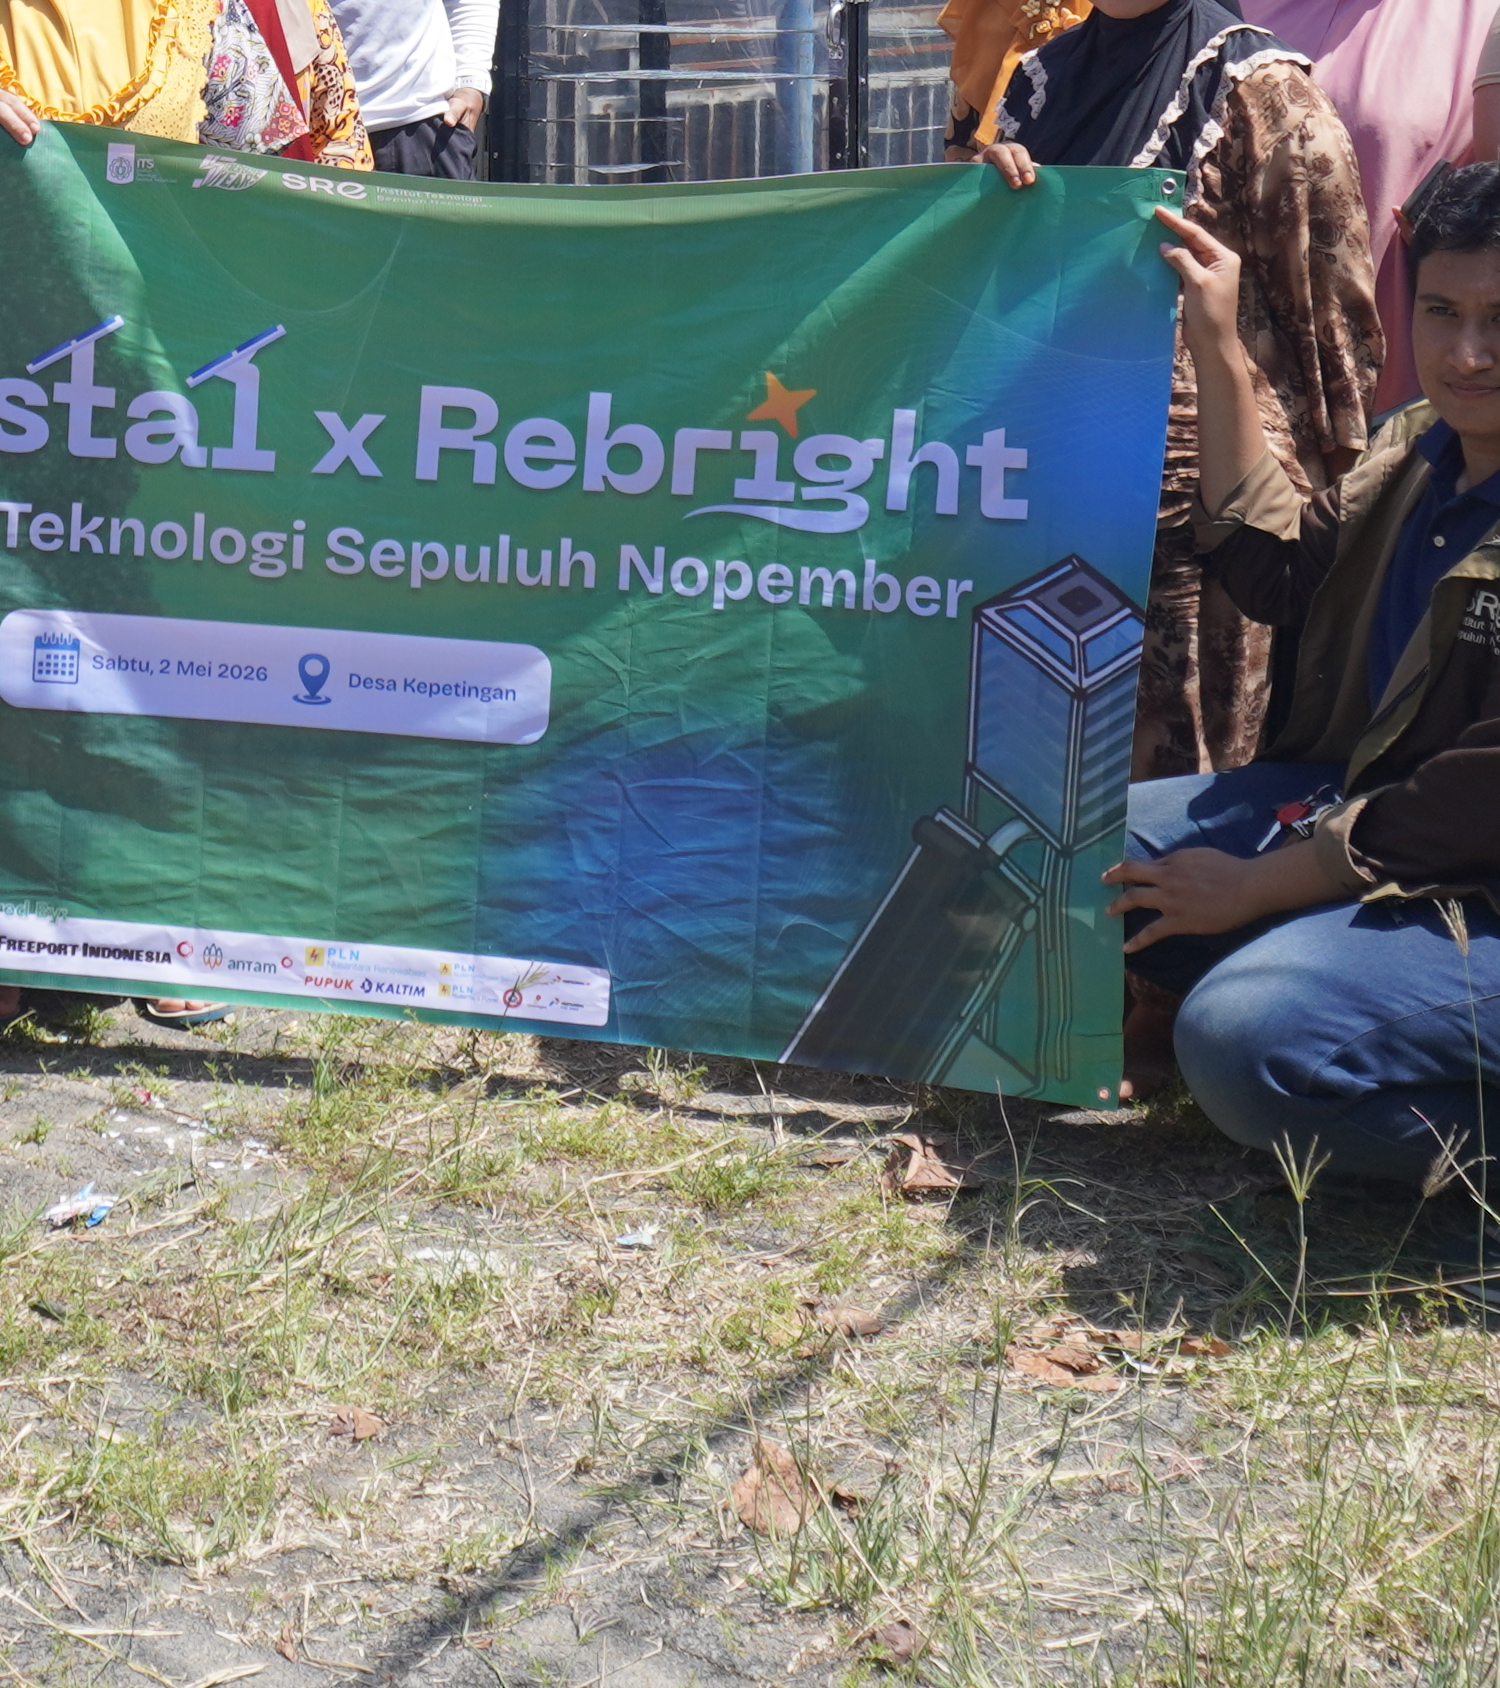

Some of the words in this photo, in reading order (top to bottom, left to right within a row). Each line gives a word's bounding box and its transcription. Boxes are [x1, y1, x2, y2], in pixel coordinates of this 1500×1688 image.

[414, 374, 1029, 536] Rebright
[324, 524, 598, 590] Sepuluh
[617, 543, 975, 620] Nopember
[91, 653, 155, 678] Sabtu,
[158, 658, 172, 675] 2
[176, 661, 213, 679] Mei
[217, 663, 268, 682] 2026
[347, 672, 398, 693] Desa
[402, 676, 518, 704] Kepetingan
[80, 942, 173, 965] INDONESIA
[326, 947, 360, 961] PLN
[304, 975, 355, 991] PUPUK
[375, 982, 427, 998] KALTIM
